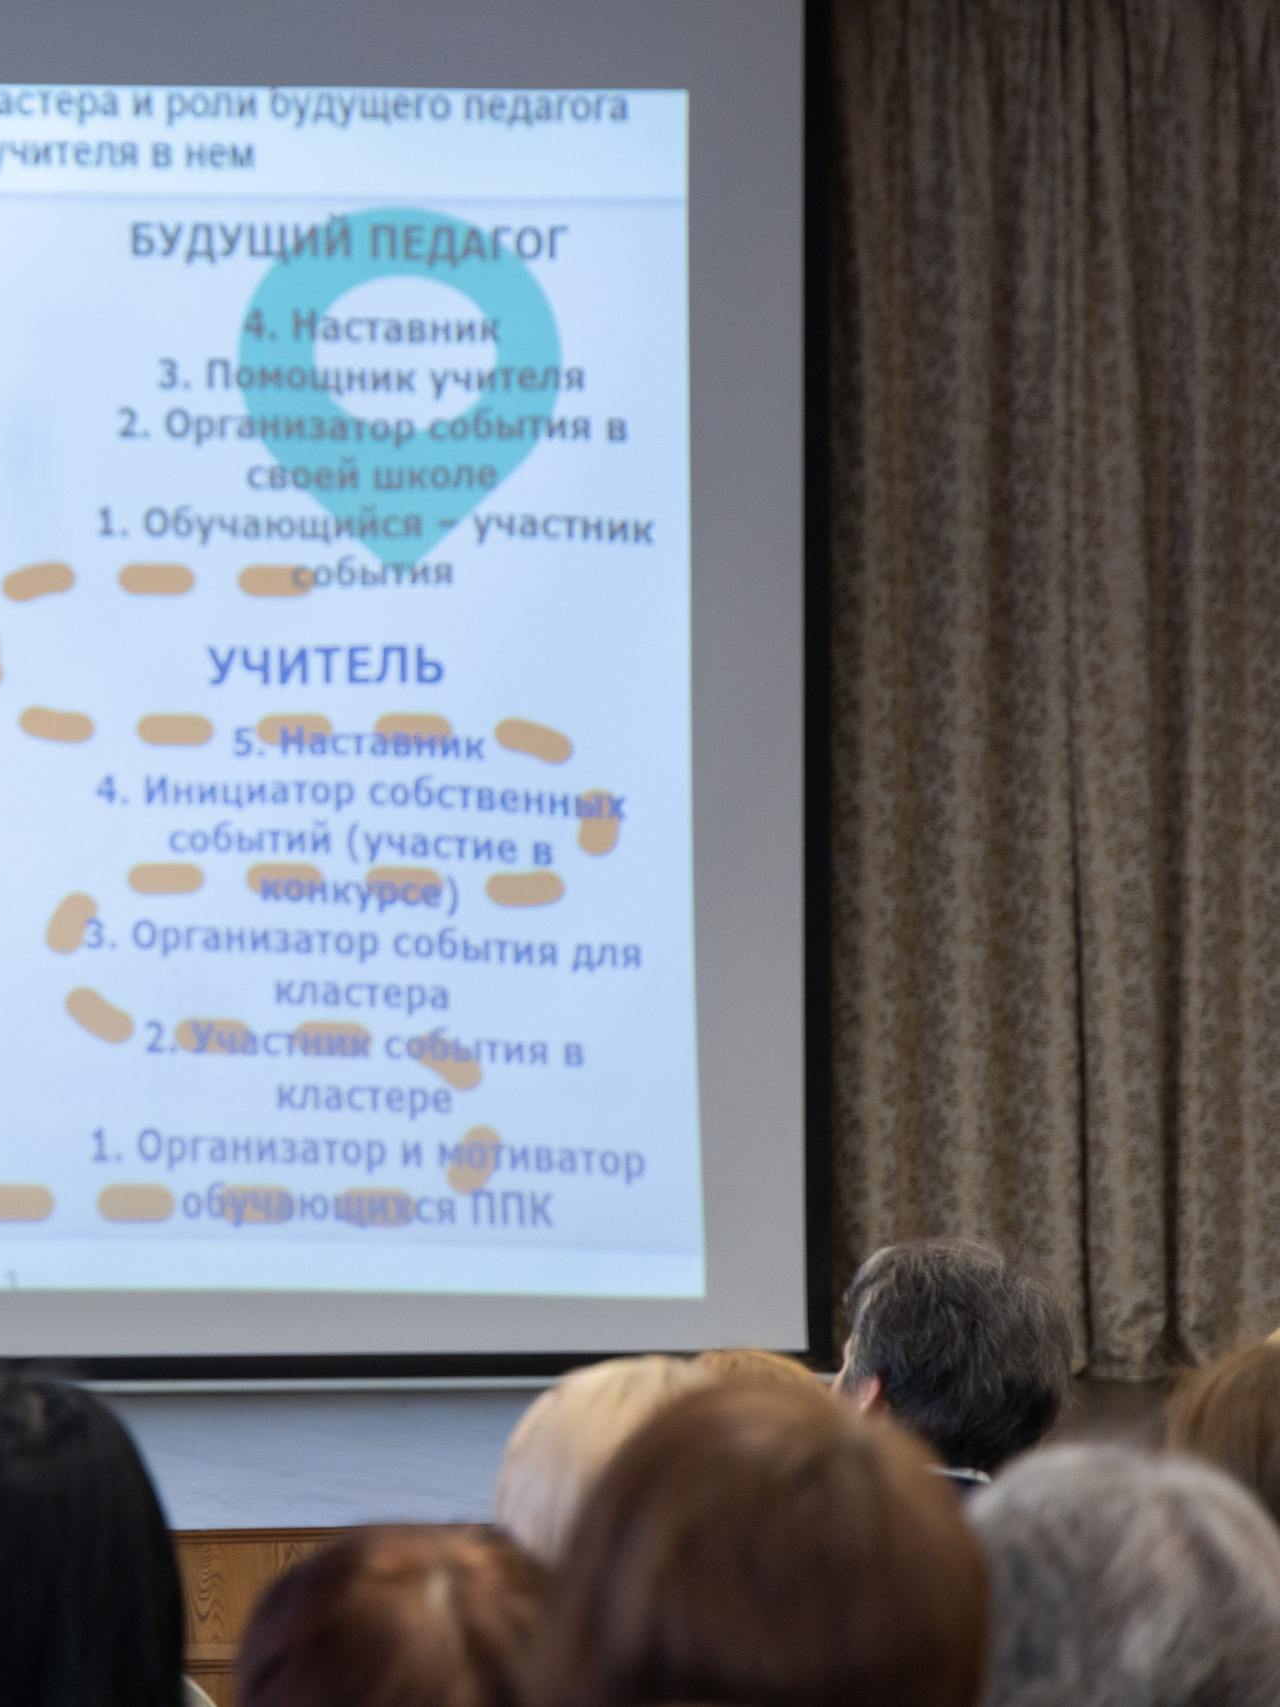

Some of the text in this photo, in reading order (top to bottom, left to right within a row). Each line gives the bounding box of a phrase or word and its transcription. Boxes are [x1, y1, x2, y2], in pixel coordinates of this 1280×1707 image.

[133, 92, 153, 117] и
[166, 93, 257, 125] роли
[269, 86, 451, 129] будущего
[464, 92, 629, 127] педагога
[151, 143, 171, 168] в
[185, 143, 256, 169] нем
[129, 212, 569, 268] БУДУЩИЙ ПЕДАГОГ
[243, 309, 502, 345] 4. Наставник
[157, 360, 585, 400] 3. Помощник учителя
[117, 409, 628, 447] 2. Организатор события в
[247, 454, 498, 491] своей школе
[97, 507, 128, 538] 1.
[144, 507, 422, 547] Обучающийся
[475, 513, 654, 547] участник
[292, 555, 453, 588] события
[207, 644, 445, 687] УЧИТЕЛЬ
[233, 727, 485, 762] 5. Наставник
[95, 774, 625, 822] 4. Инициатор собственных
[169, 820, 554, 867] событий (участие в
[259, 875, 460, 918] конкурсе)
[84, 919, 642, 972] 3. Организатор события для
[275, 976, 449, 1014] кластера
[146, 1020, 585, 1067] 2. Участник события в
[277, 1080, 453, 1118] кластере
[91, 1130, 646, 1181] 1. Организатор и мотиватор
[182, 1181, 554, 1228] обучающихся ППК
